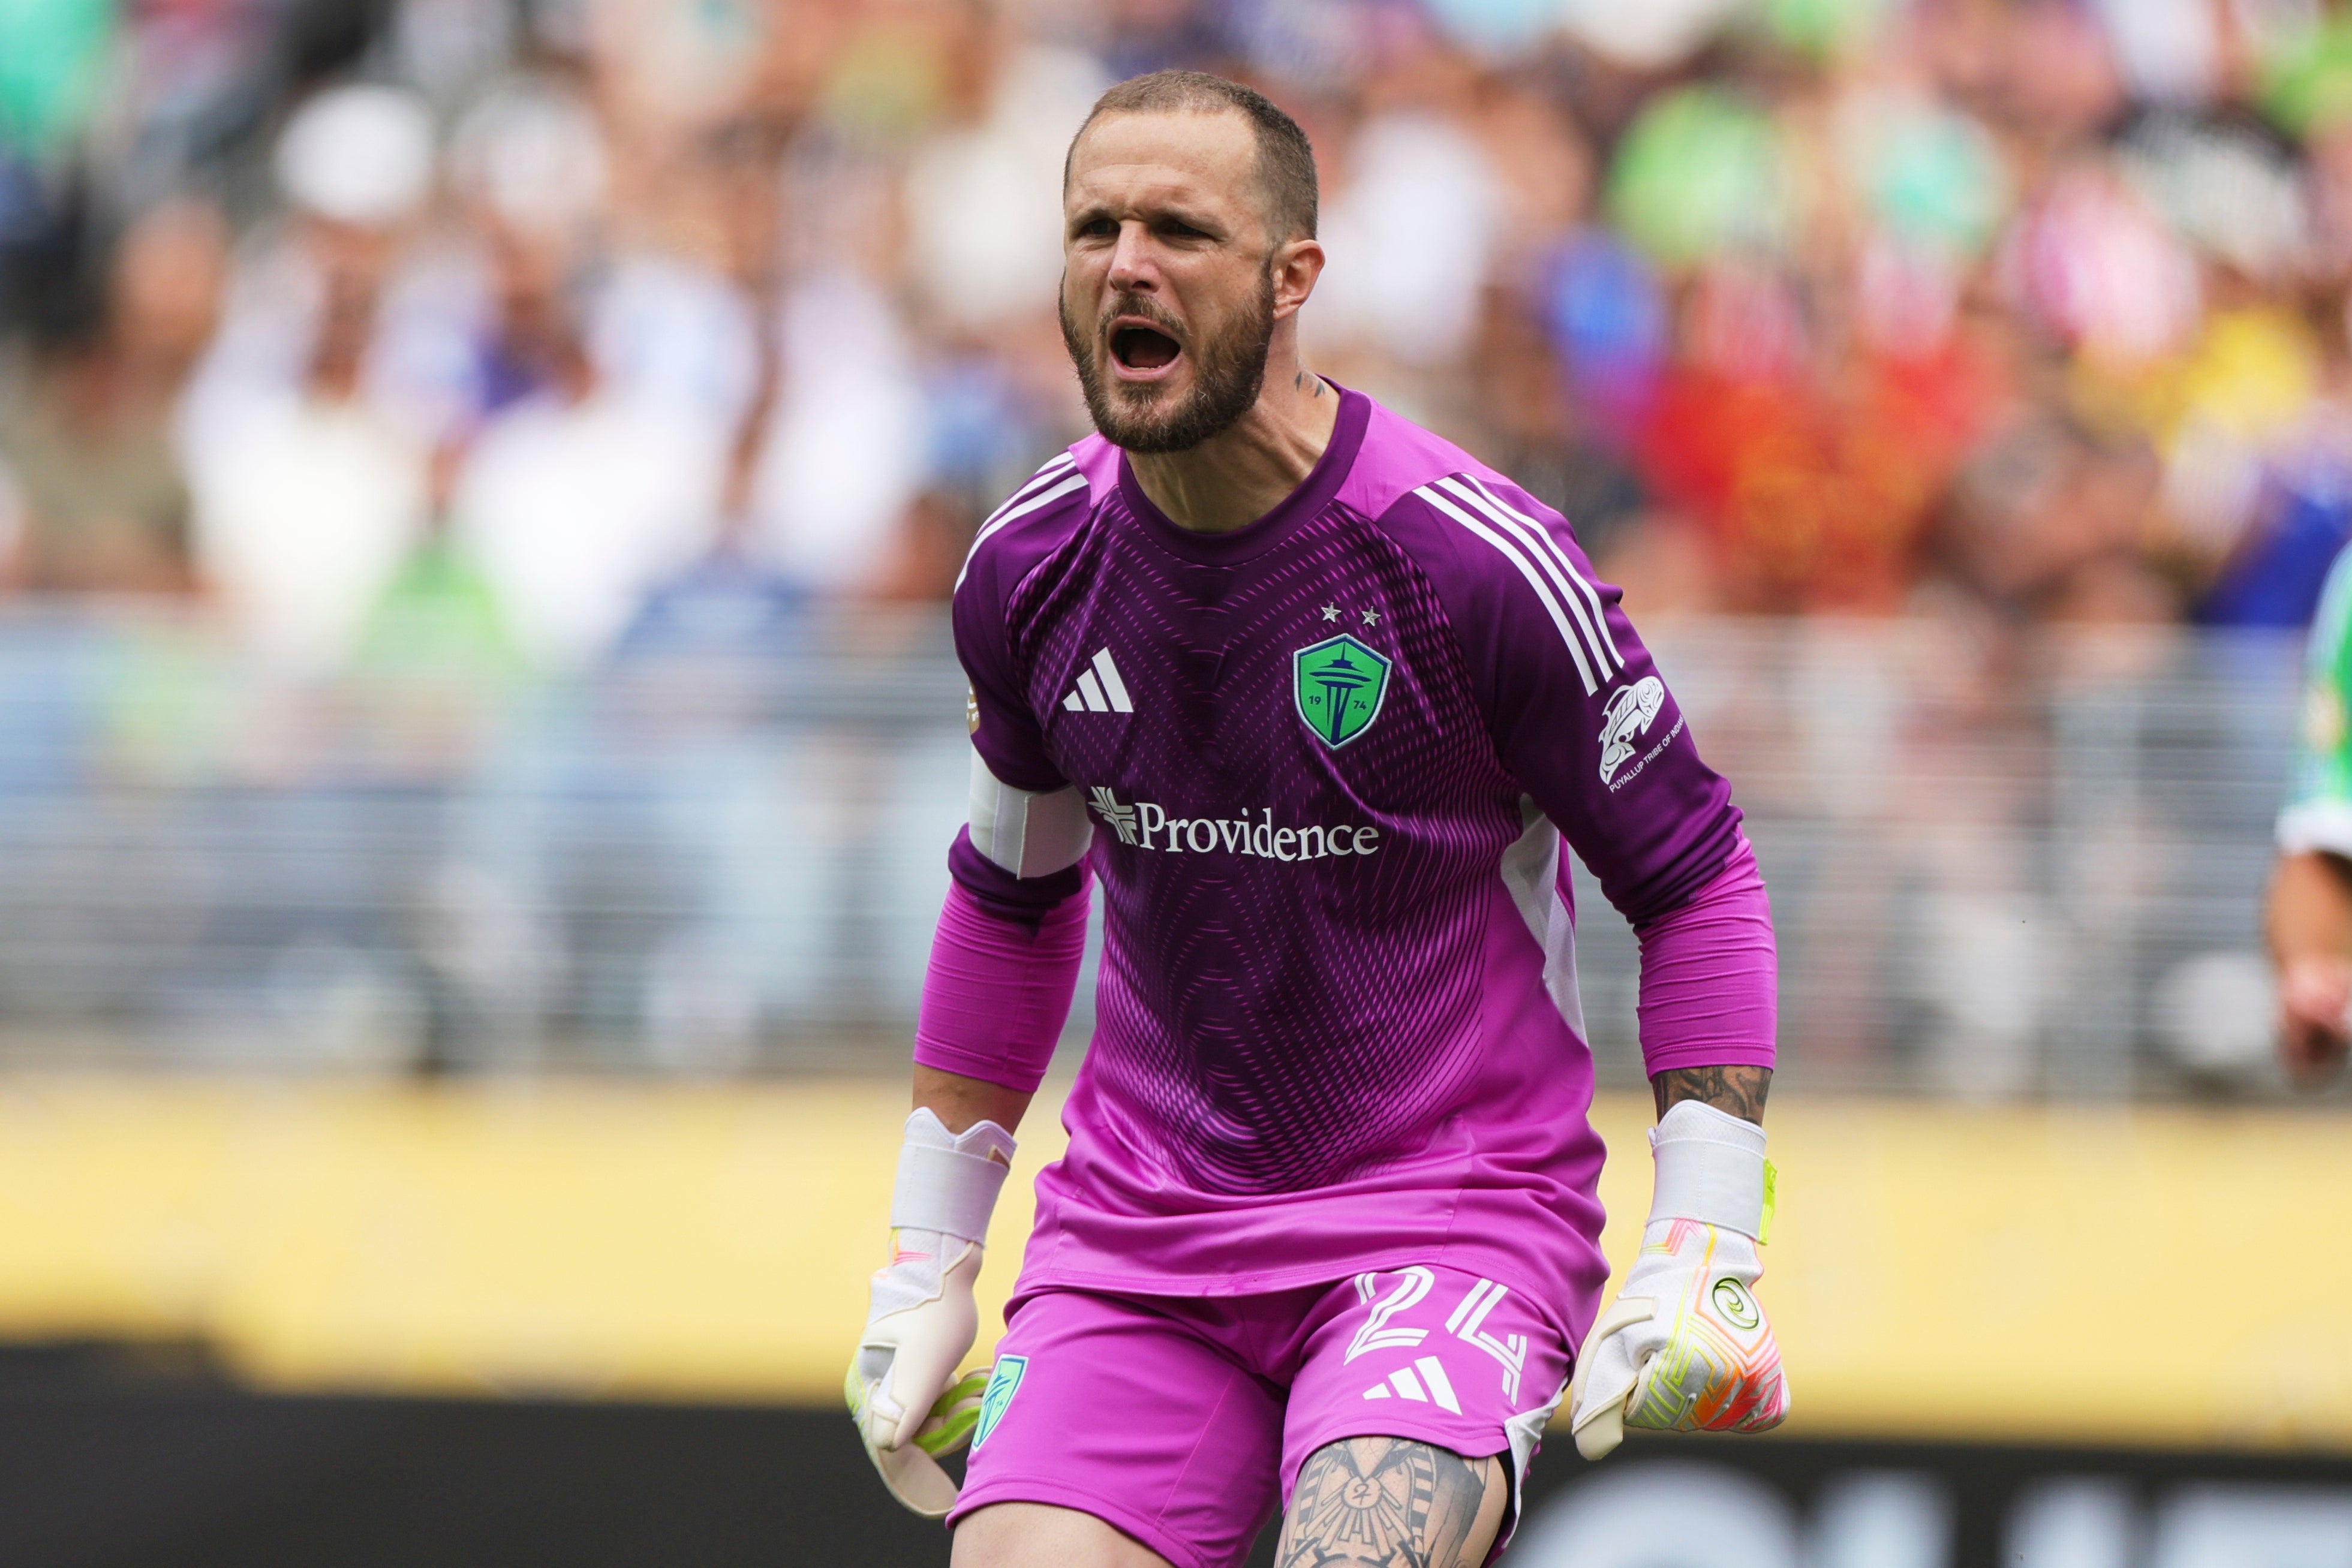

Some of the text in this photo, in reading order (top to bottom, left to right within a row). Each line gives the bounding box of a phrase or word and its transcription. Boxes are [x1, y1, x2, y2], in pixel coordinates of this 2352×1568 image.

[1309, 696, 1367, 710] 19 74
[1609, 762, 1644, 793] PUYALLUP
[1643, 742, 1663, 765] TRIBE
[1662, 734, 1671, 747] OF
[1135, 802, 1379, 861] Providence
[1343, 1265, 1527, 1407] 24
